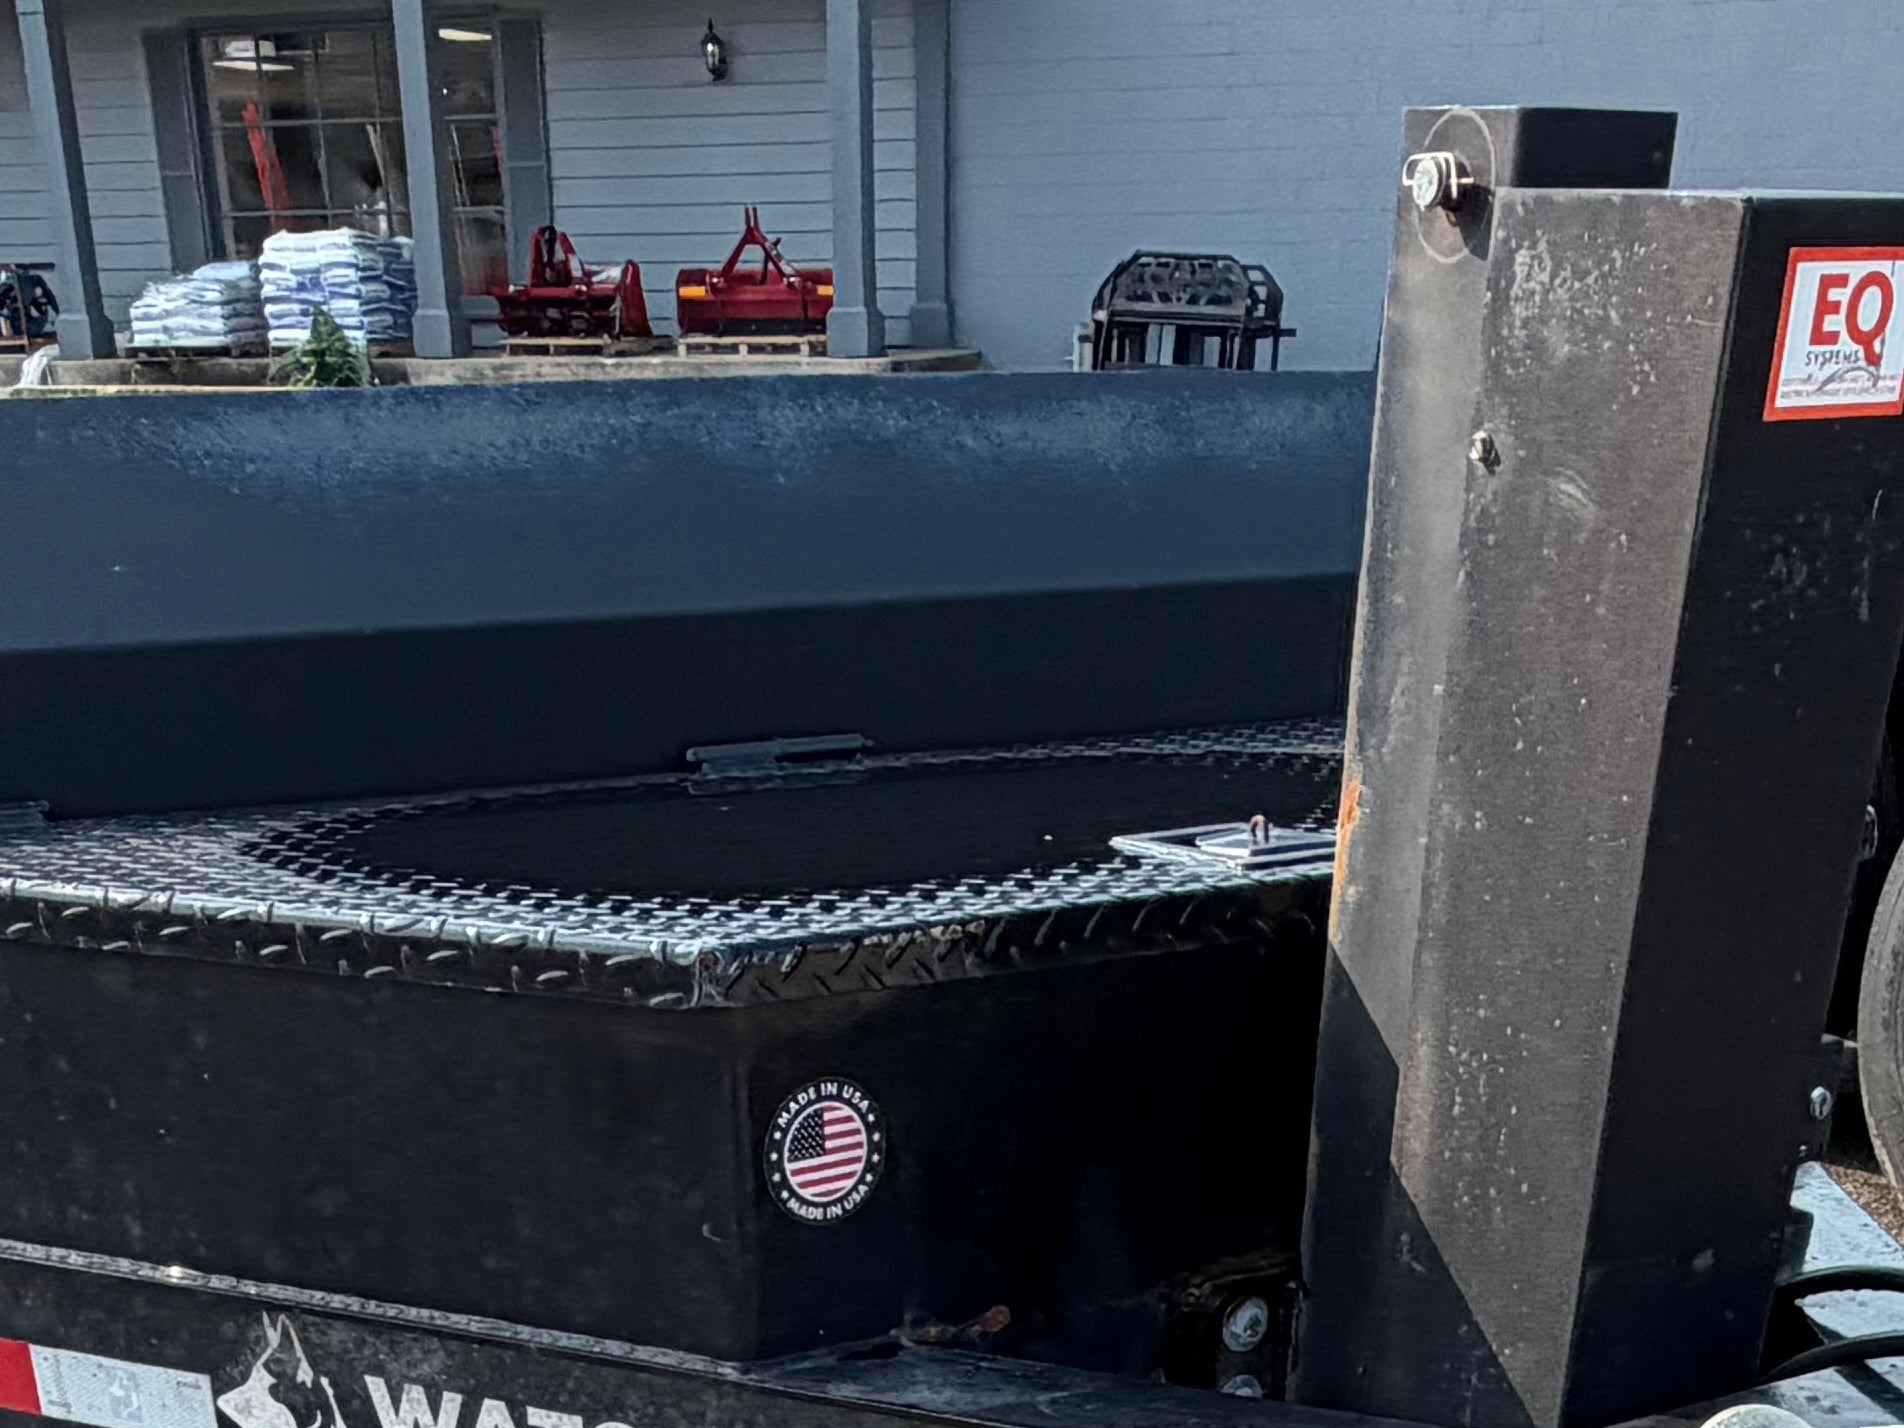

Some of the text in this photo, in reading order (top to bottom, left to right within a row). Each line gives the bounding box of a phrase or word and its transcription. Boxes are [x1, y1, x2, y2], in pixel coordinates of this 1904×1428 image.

[1809, 270, 1894, 367] EQ
[1805, 350, 1860, 368] SYSTEMS
[777, 1082, 870, 1128] MADE IN USA
[786, 1184, 870, 1220] MADE IN USA
